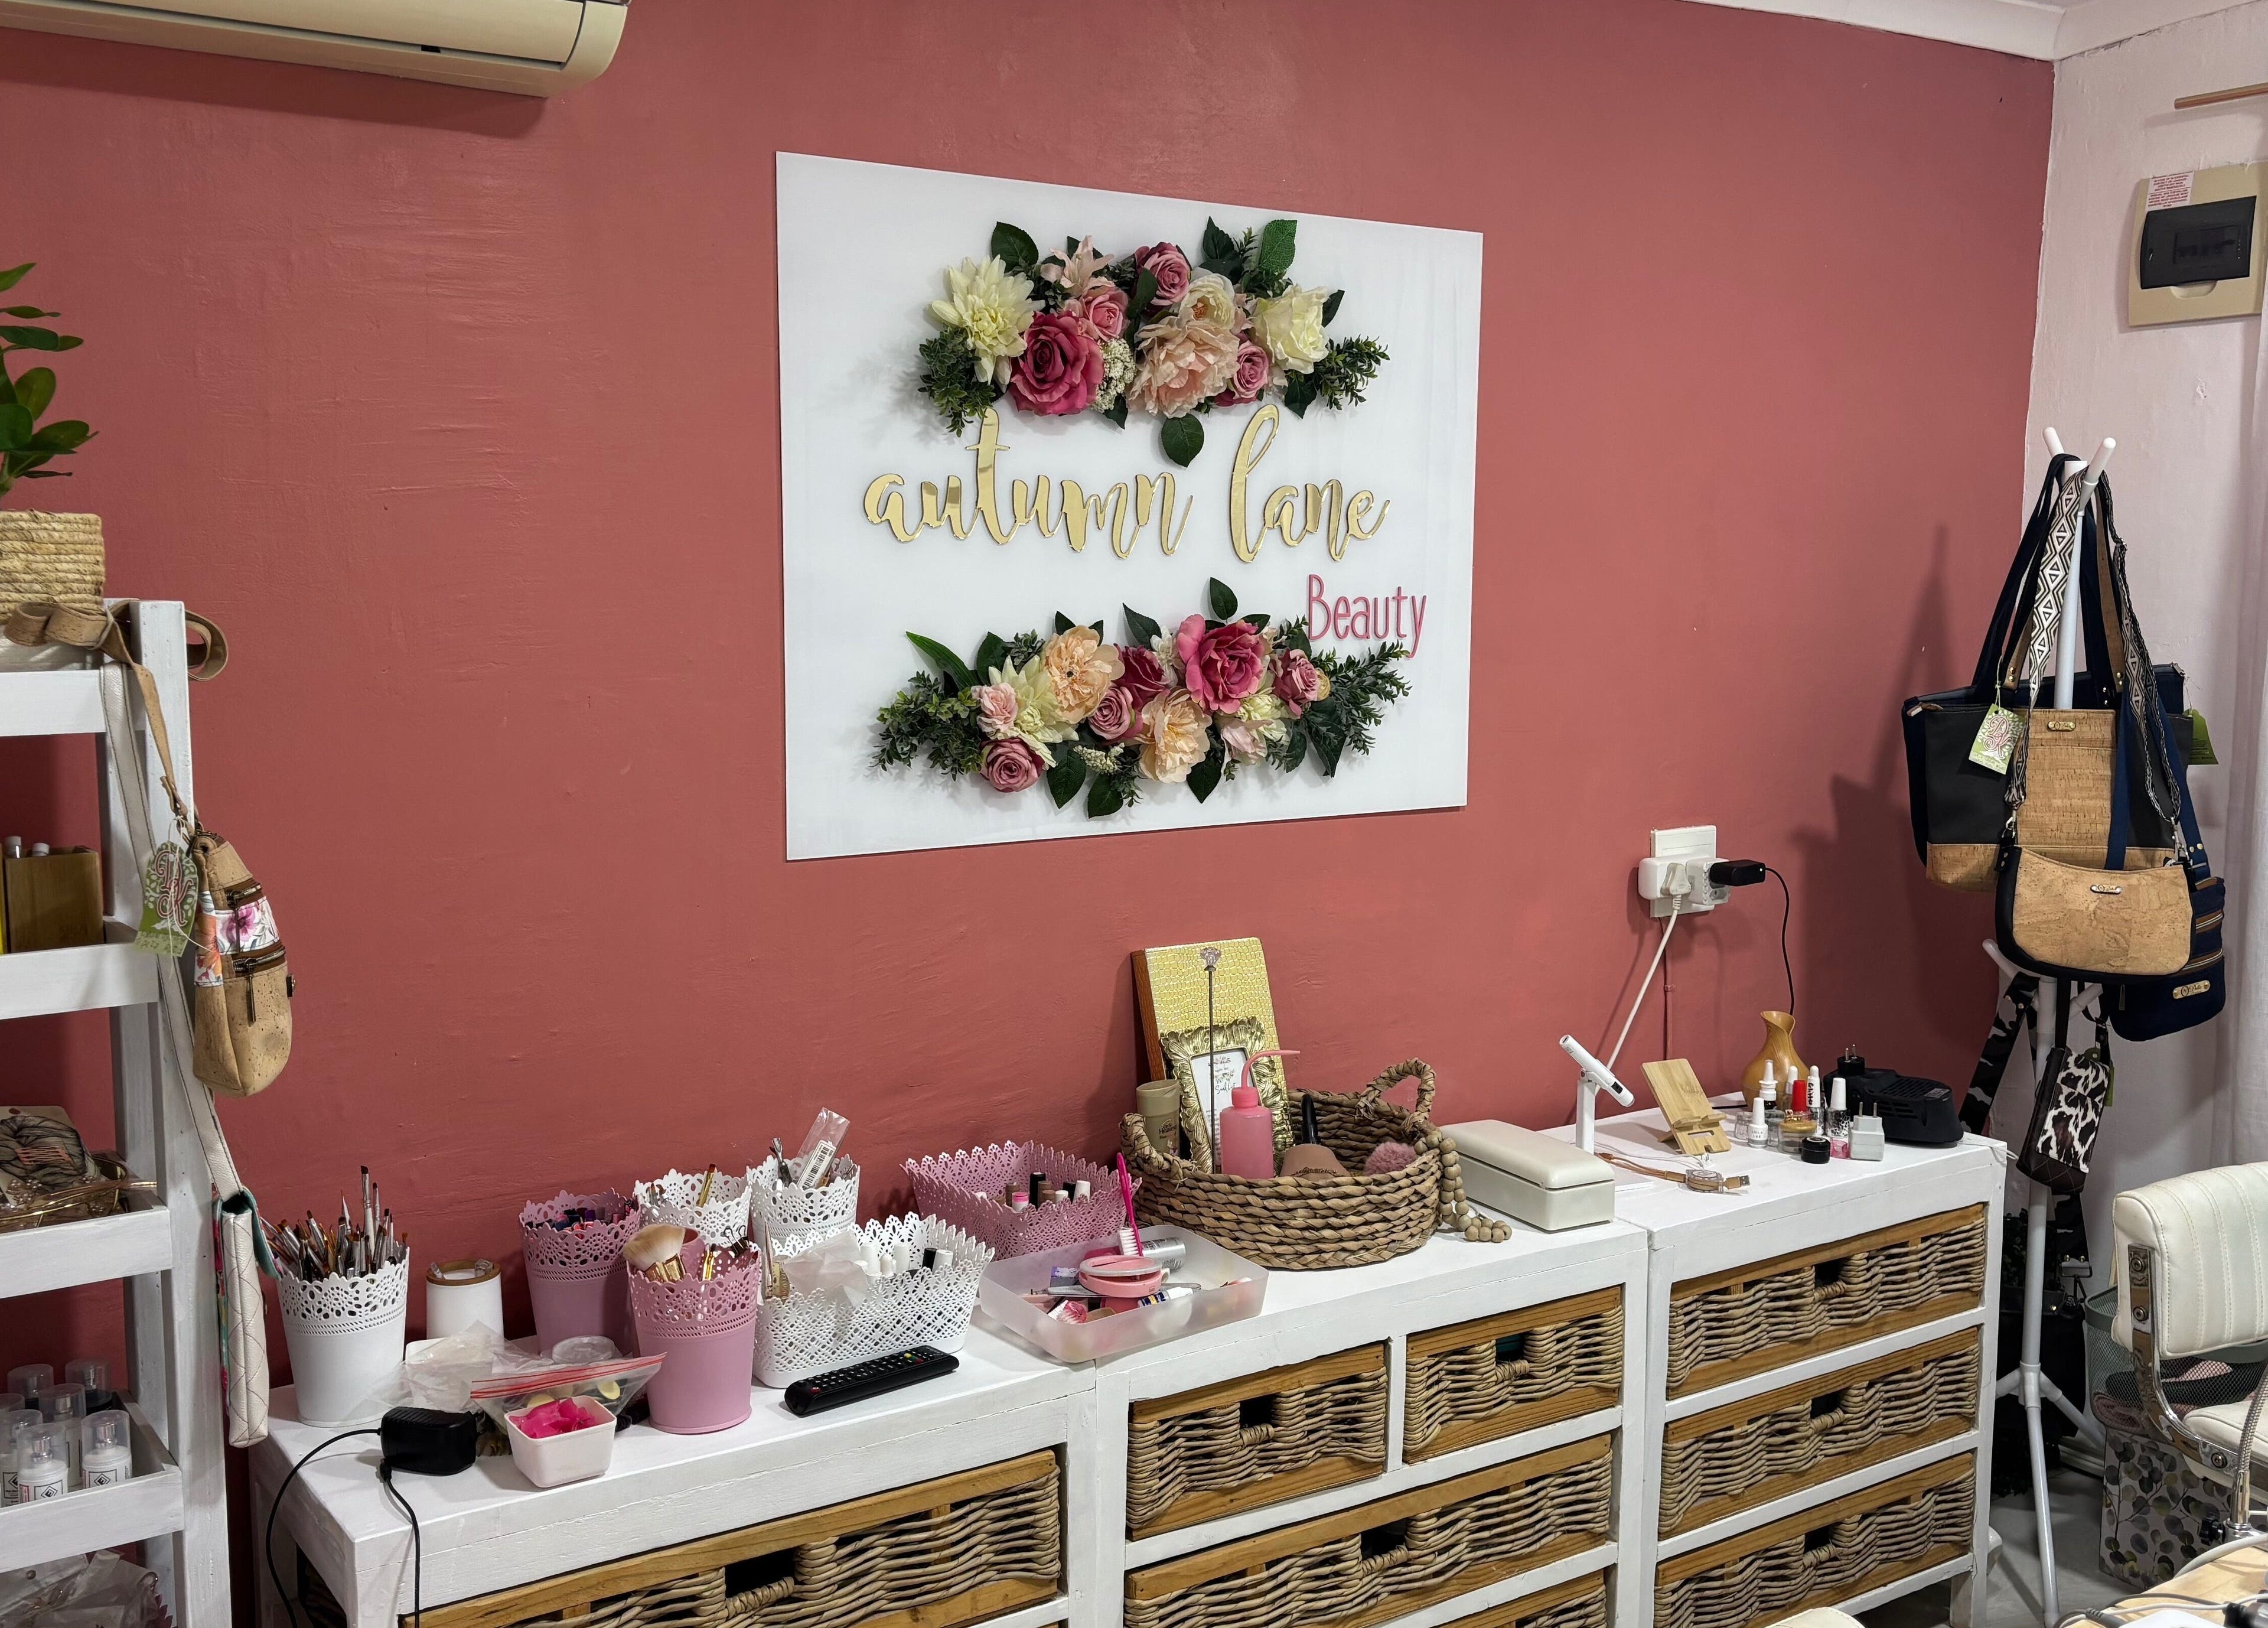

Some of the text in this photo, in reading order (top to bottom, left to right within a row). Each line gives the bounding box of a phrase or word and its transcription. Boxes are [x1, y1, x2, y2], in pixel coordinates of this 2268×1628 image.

[863, 404, 1390, 562] autumn lane
[1306, 574, 1427, 659] Beauty
